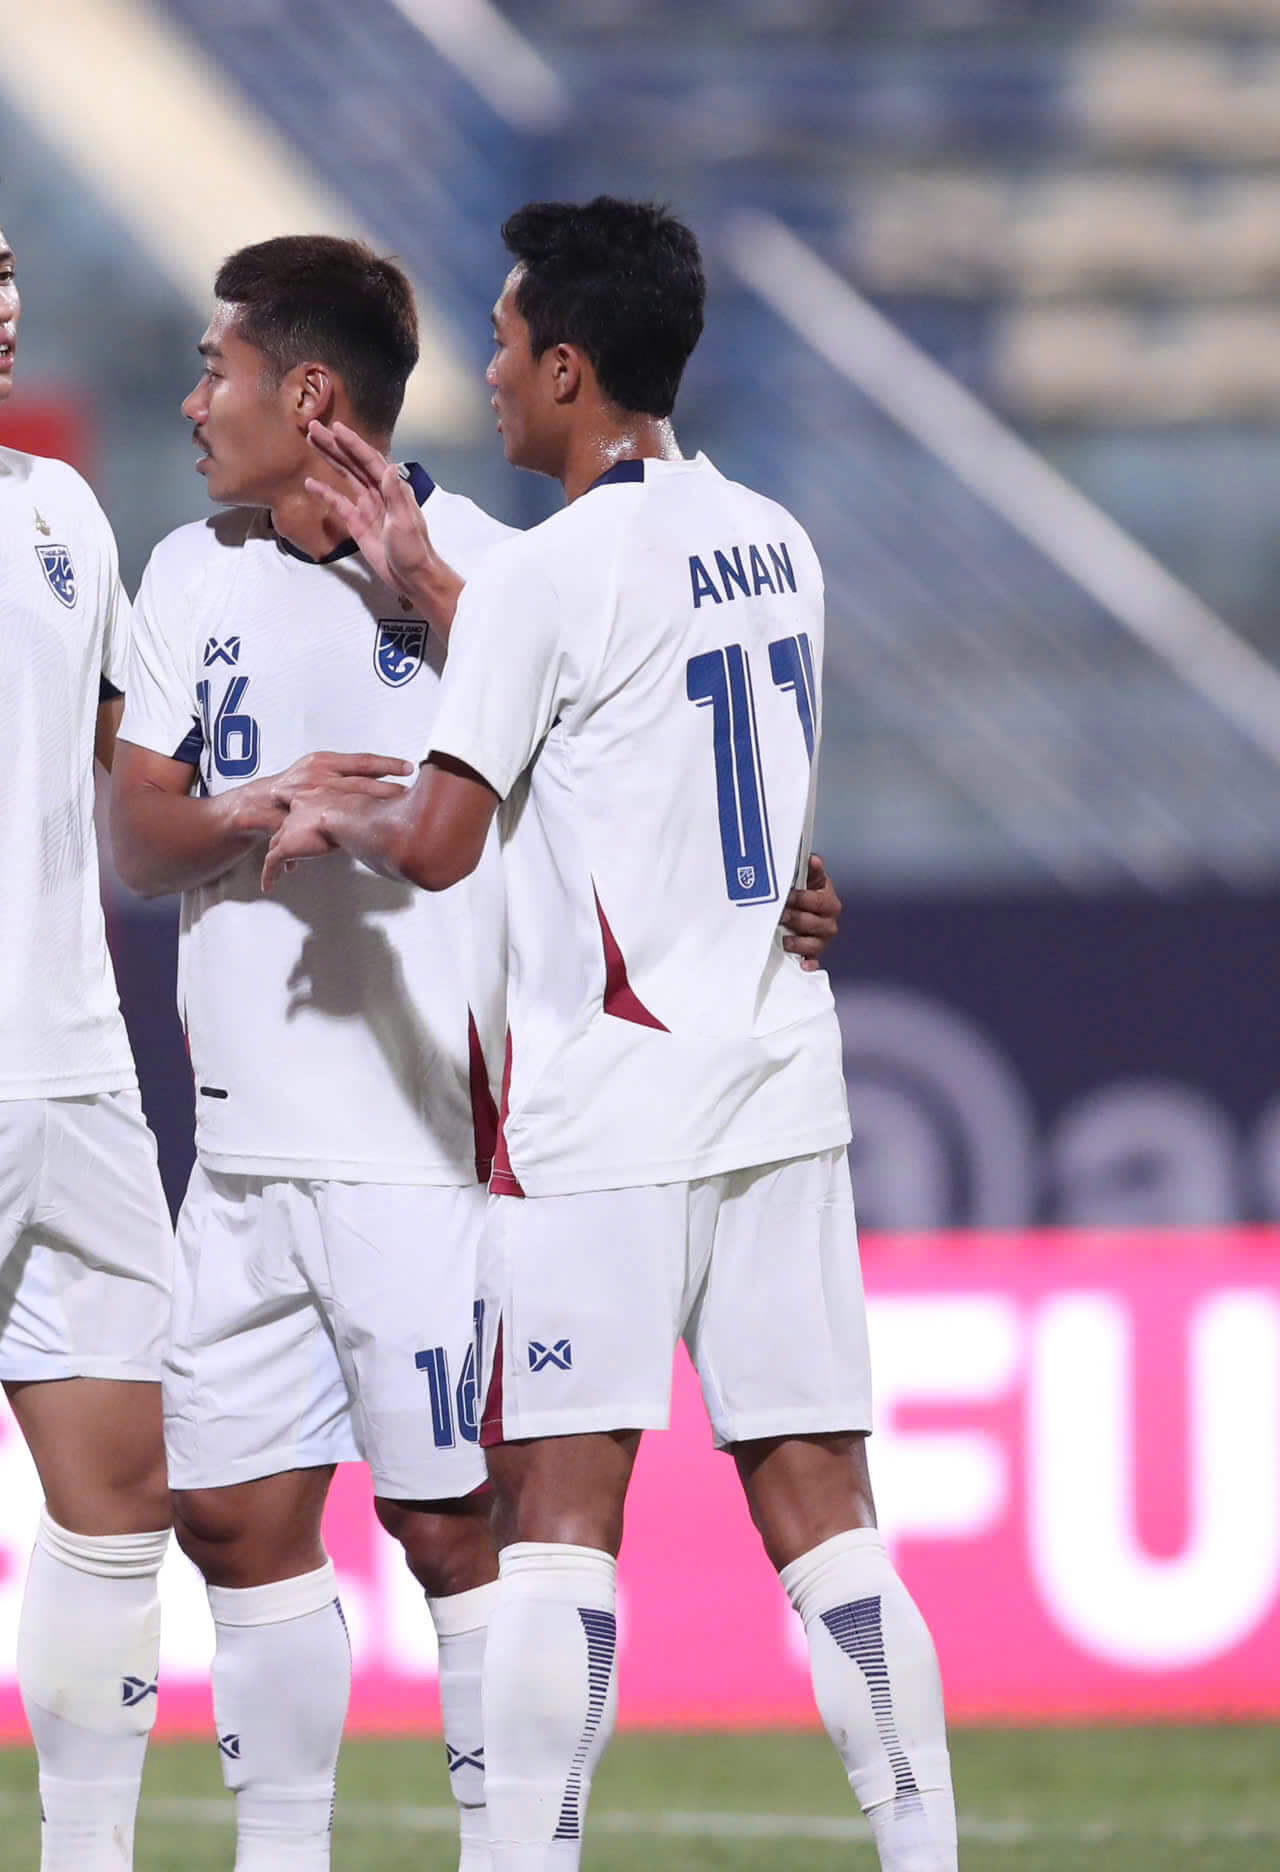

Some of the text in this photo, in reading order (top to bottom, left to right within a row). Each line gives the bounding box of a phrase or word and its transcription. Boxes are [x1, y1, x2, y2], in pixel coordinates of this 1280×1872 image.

[688, 542, 797, 608] ANAN
[196, 675, 261, 780] 16
[686, 632, 817, 906] 11
